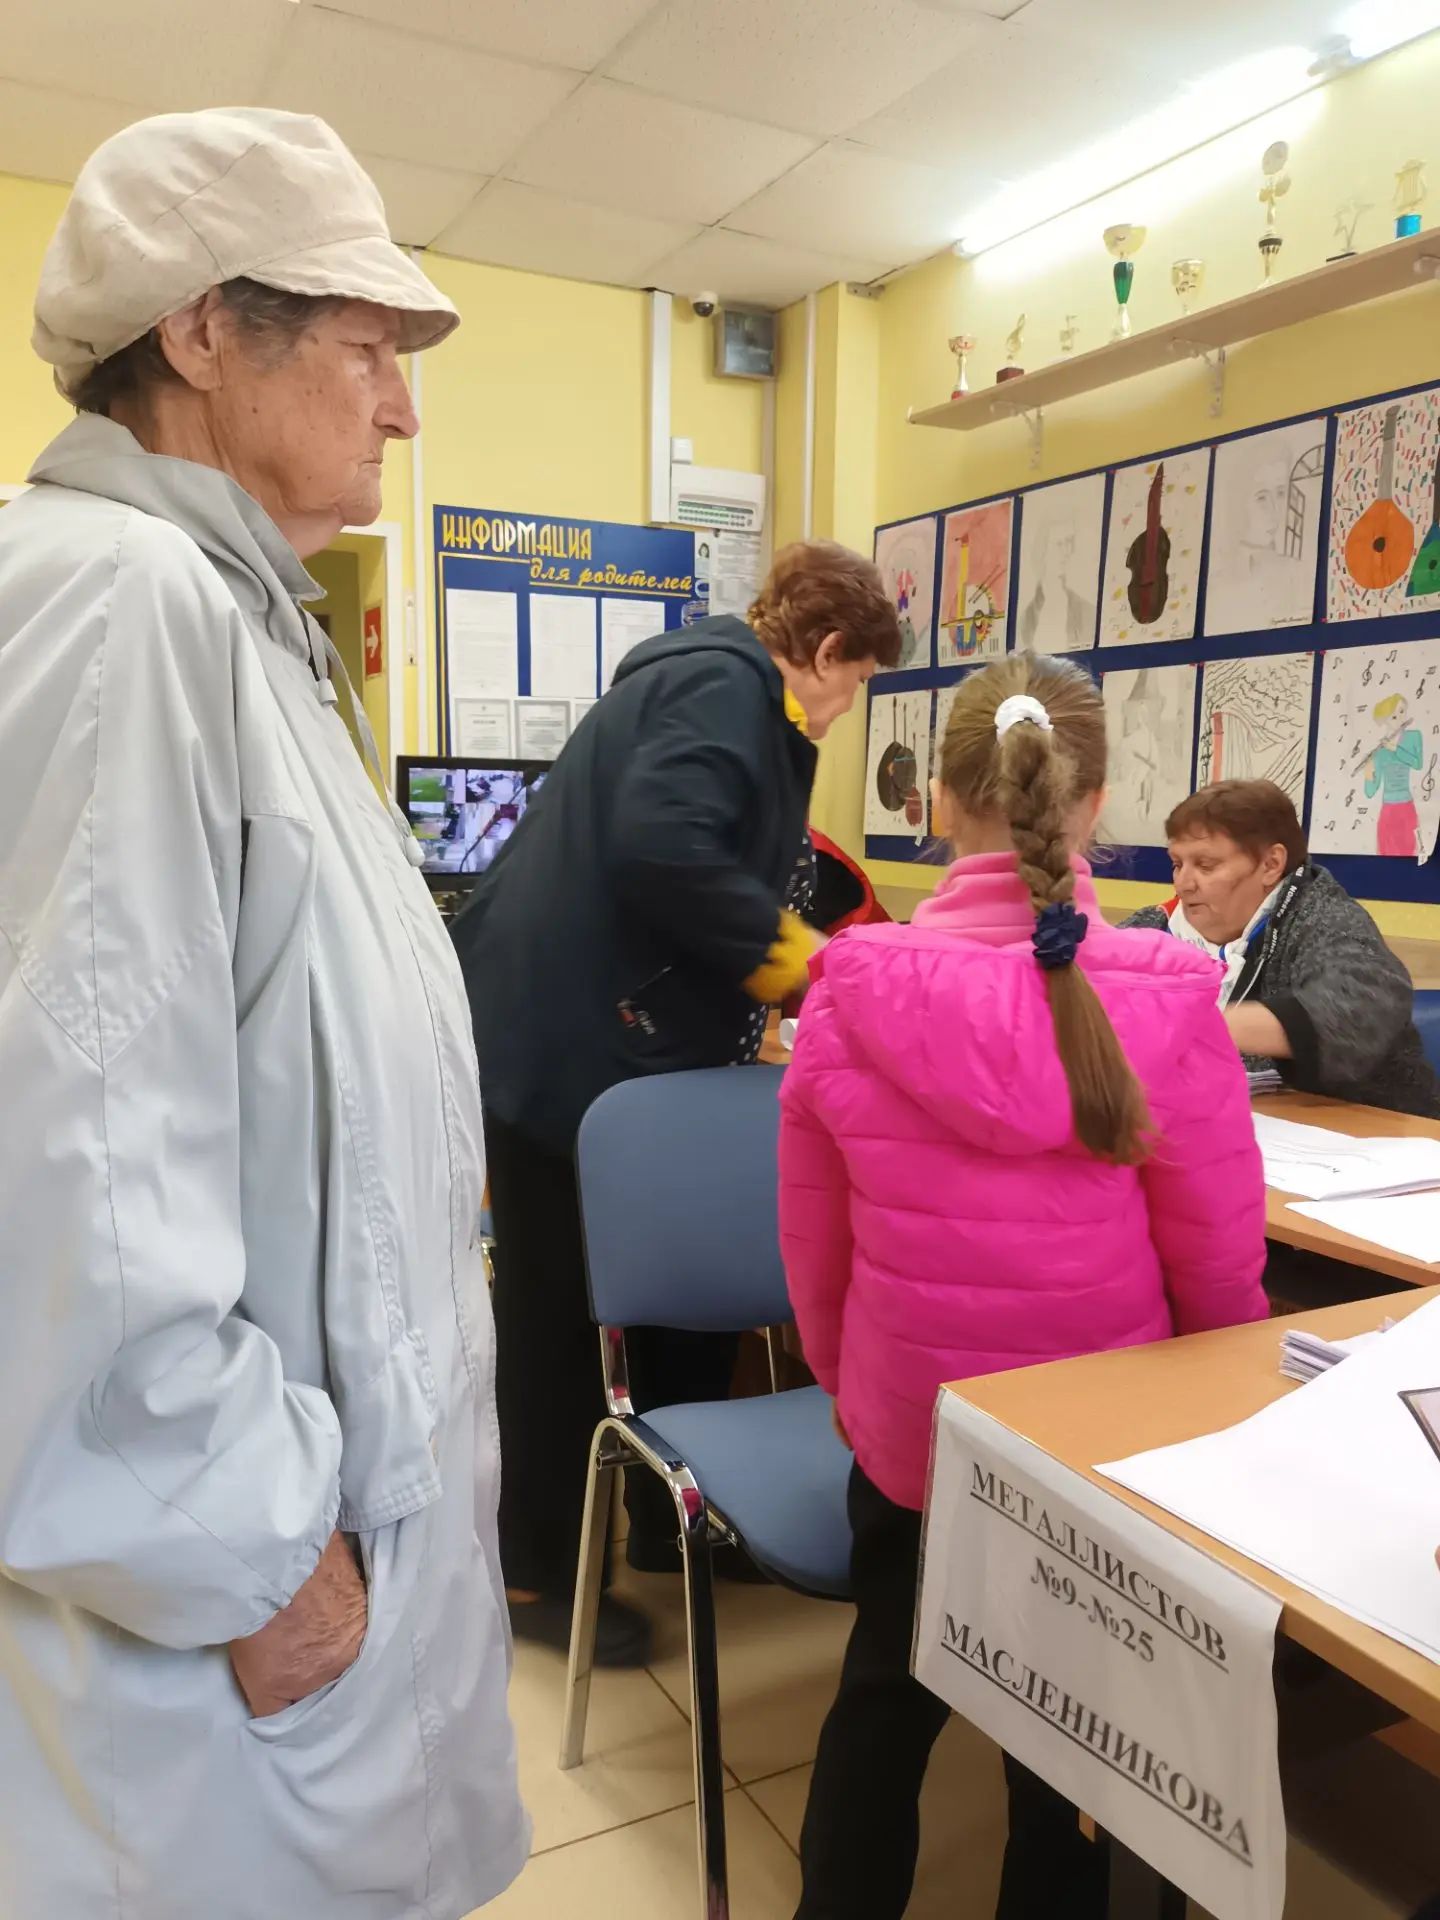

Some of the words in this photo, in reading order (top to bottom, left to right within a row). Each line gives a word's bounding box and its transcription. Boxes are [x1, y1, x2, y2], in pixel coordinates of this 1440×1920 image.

[442, 513, 592, 561] ИНФОРМАЦИЯ
[530, 557, 570, 582] для
[578, 563, 692, 591] родителей
[971, 1461, 1227, 1662] МЕТАЛЛИСТОВ
[1030, 1556, 1155, 1663] №9-№25
[943, 1612, 1253, 1857] МАСЛЕННИКОВА
